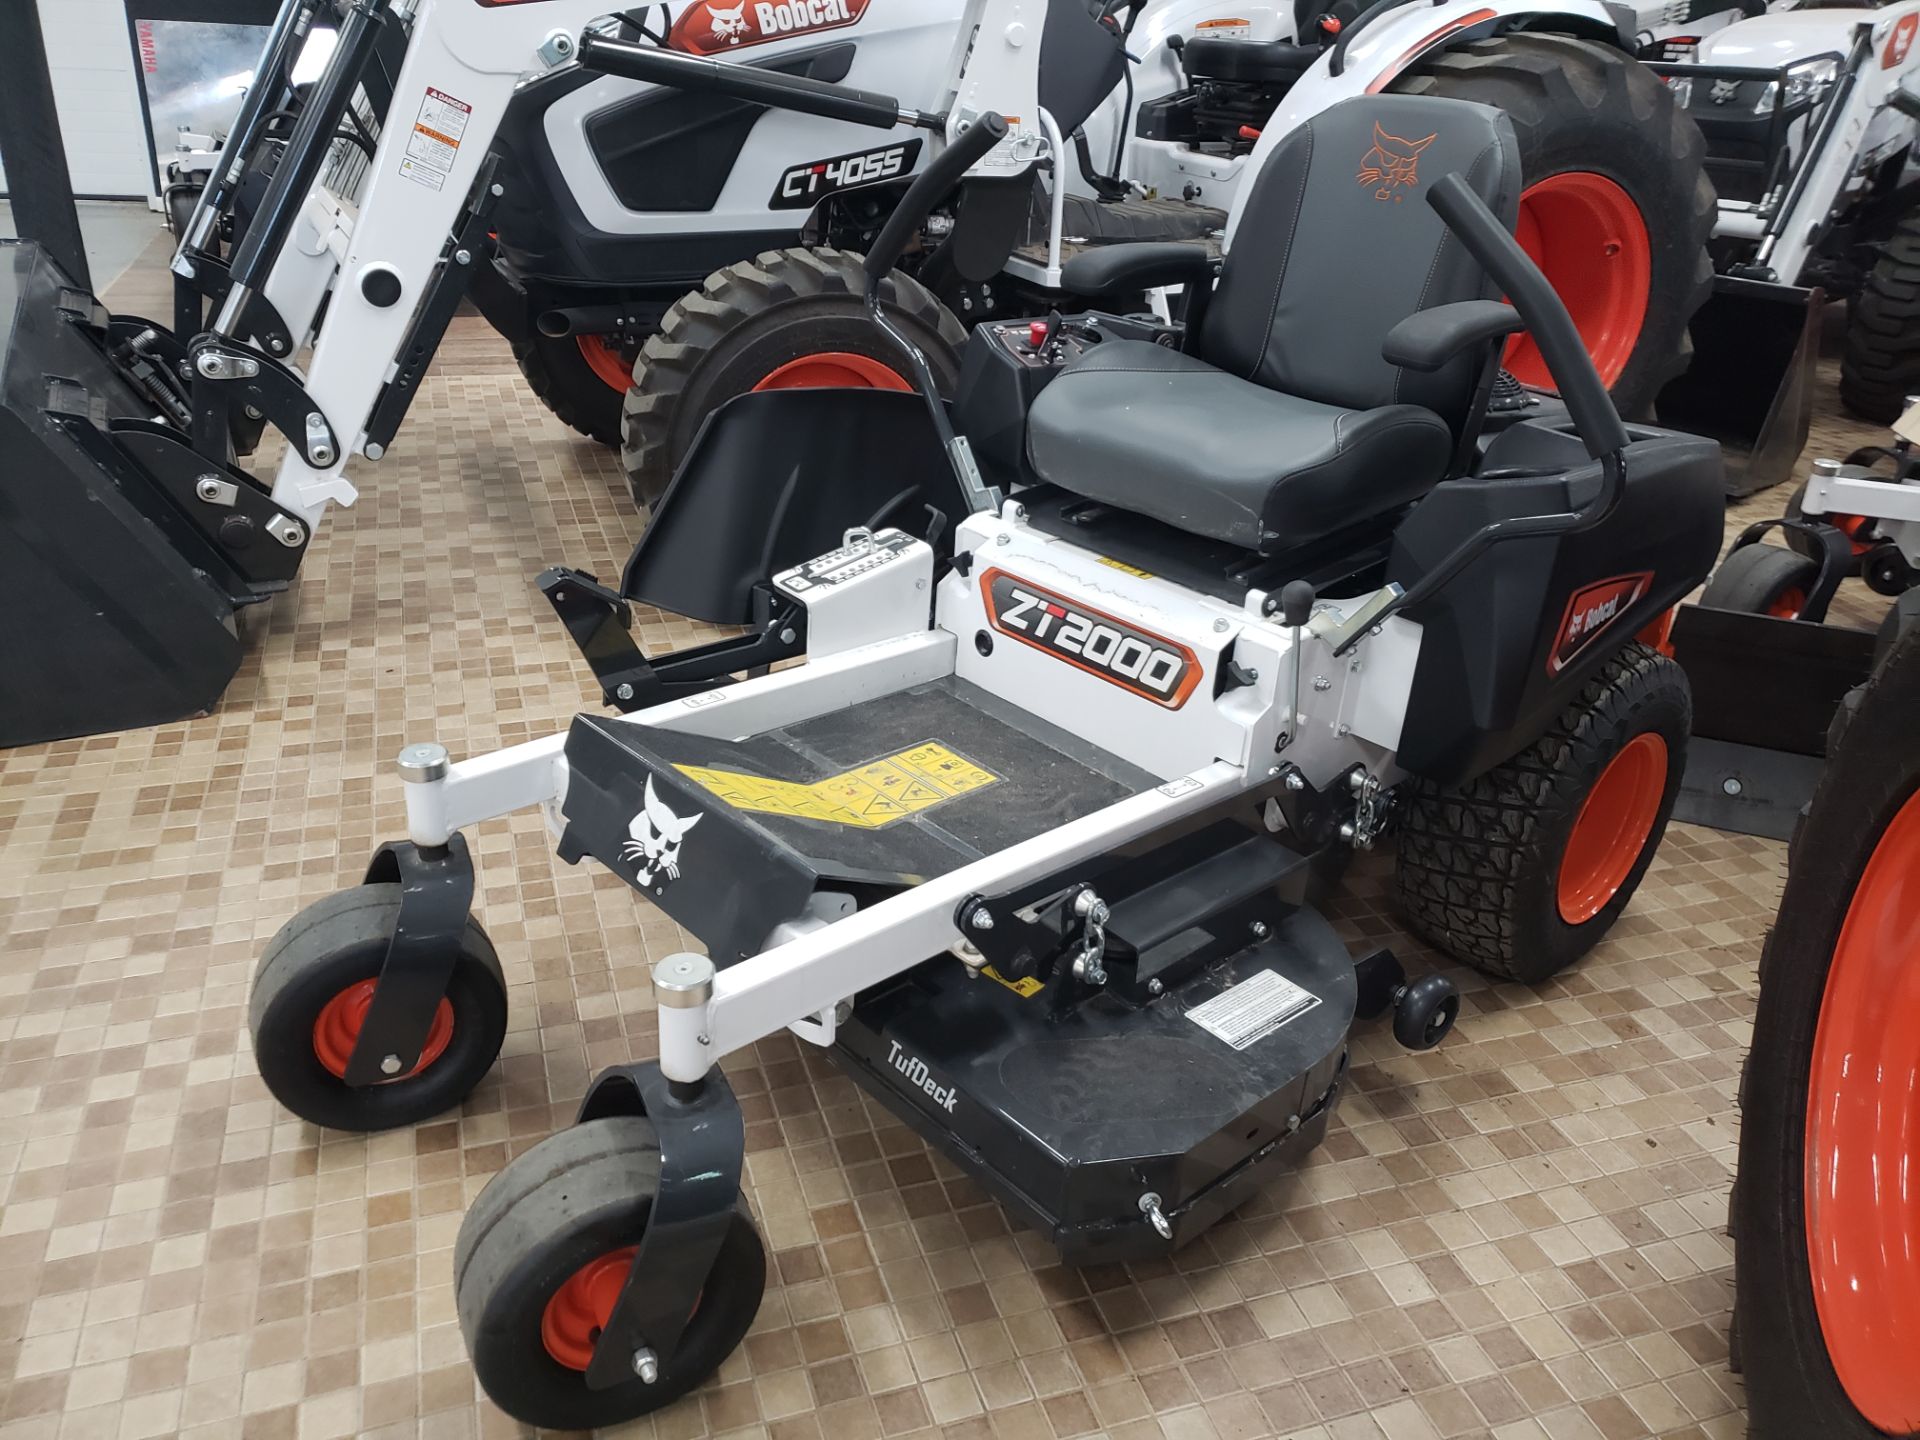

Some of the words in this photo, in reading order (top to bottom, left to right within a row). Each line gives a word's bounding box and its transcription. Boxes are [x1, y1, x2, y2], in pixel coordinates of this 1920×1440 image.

[755, 0, 850, 35] Bobcat
[140, 22, 157, 73] YAMAHA
[438, 93, 468, 112] DANGER
[782, 147, 905, 198] CT4055
[1584, 593, 1619, 633] Bobcat
[1000, 587, 1184, 693] ZT2000
[887, 1039, 958, 1113] TufDeck
